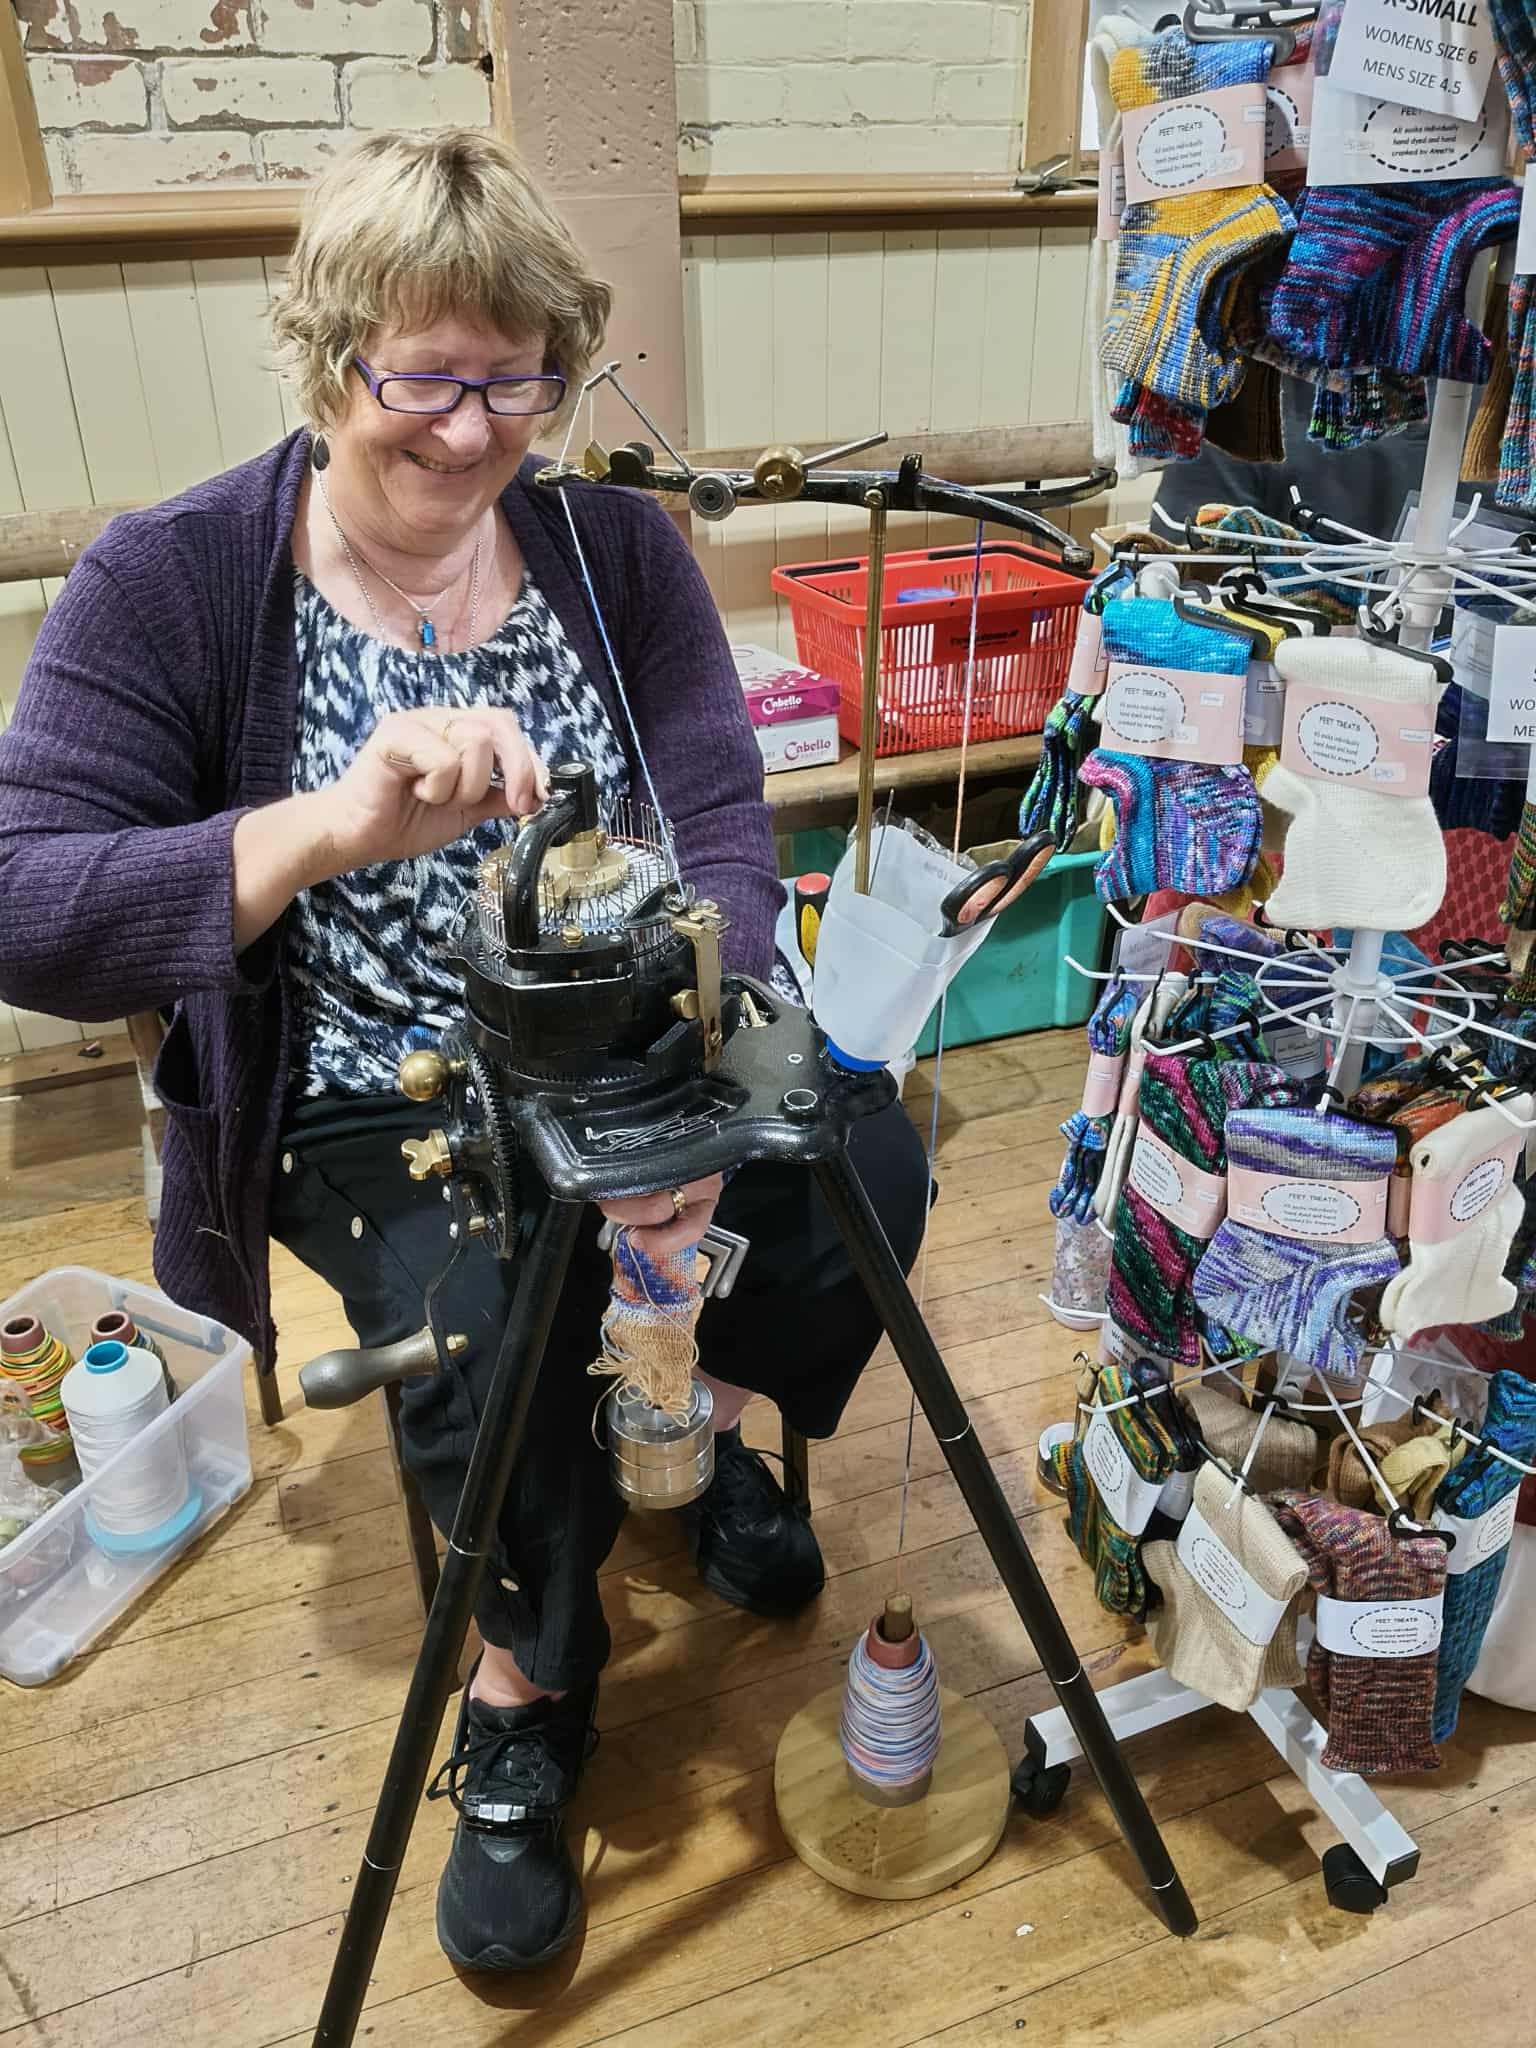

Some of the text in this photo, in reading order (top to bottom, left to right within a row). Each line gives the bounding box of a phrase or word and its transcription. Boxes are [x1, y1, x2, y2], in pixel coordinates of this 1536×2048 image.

[1366, 24, 1478, 65] WOMENS SIZE 6
[1363, 57, 1462, 96] MENS SIZE 4.5
[1125, 687, 1167, 698] FEET TREATS
[762, 696, 802, 715] Cabello
[1320, 716, 1360, 731] FEET TREATS
[784, 739, 832, 760] Cabello
